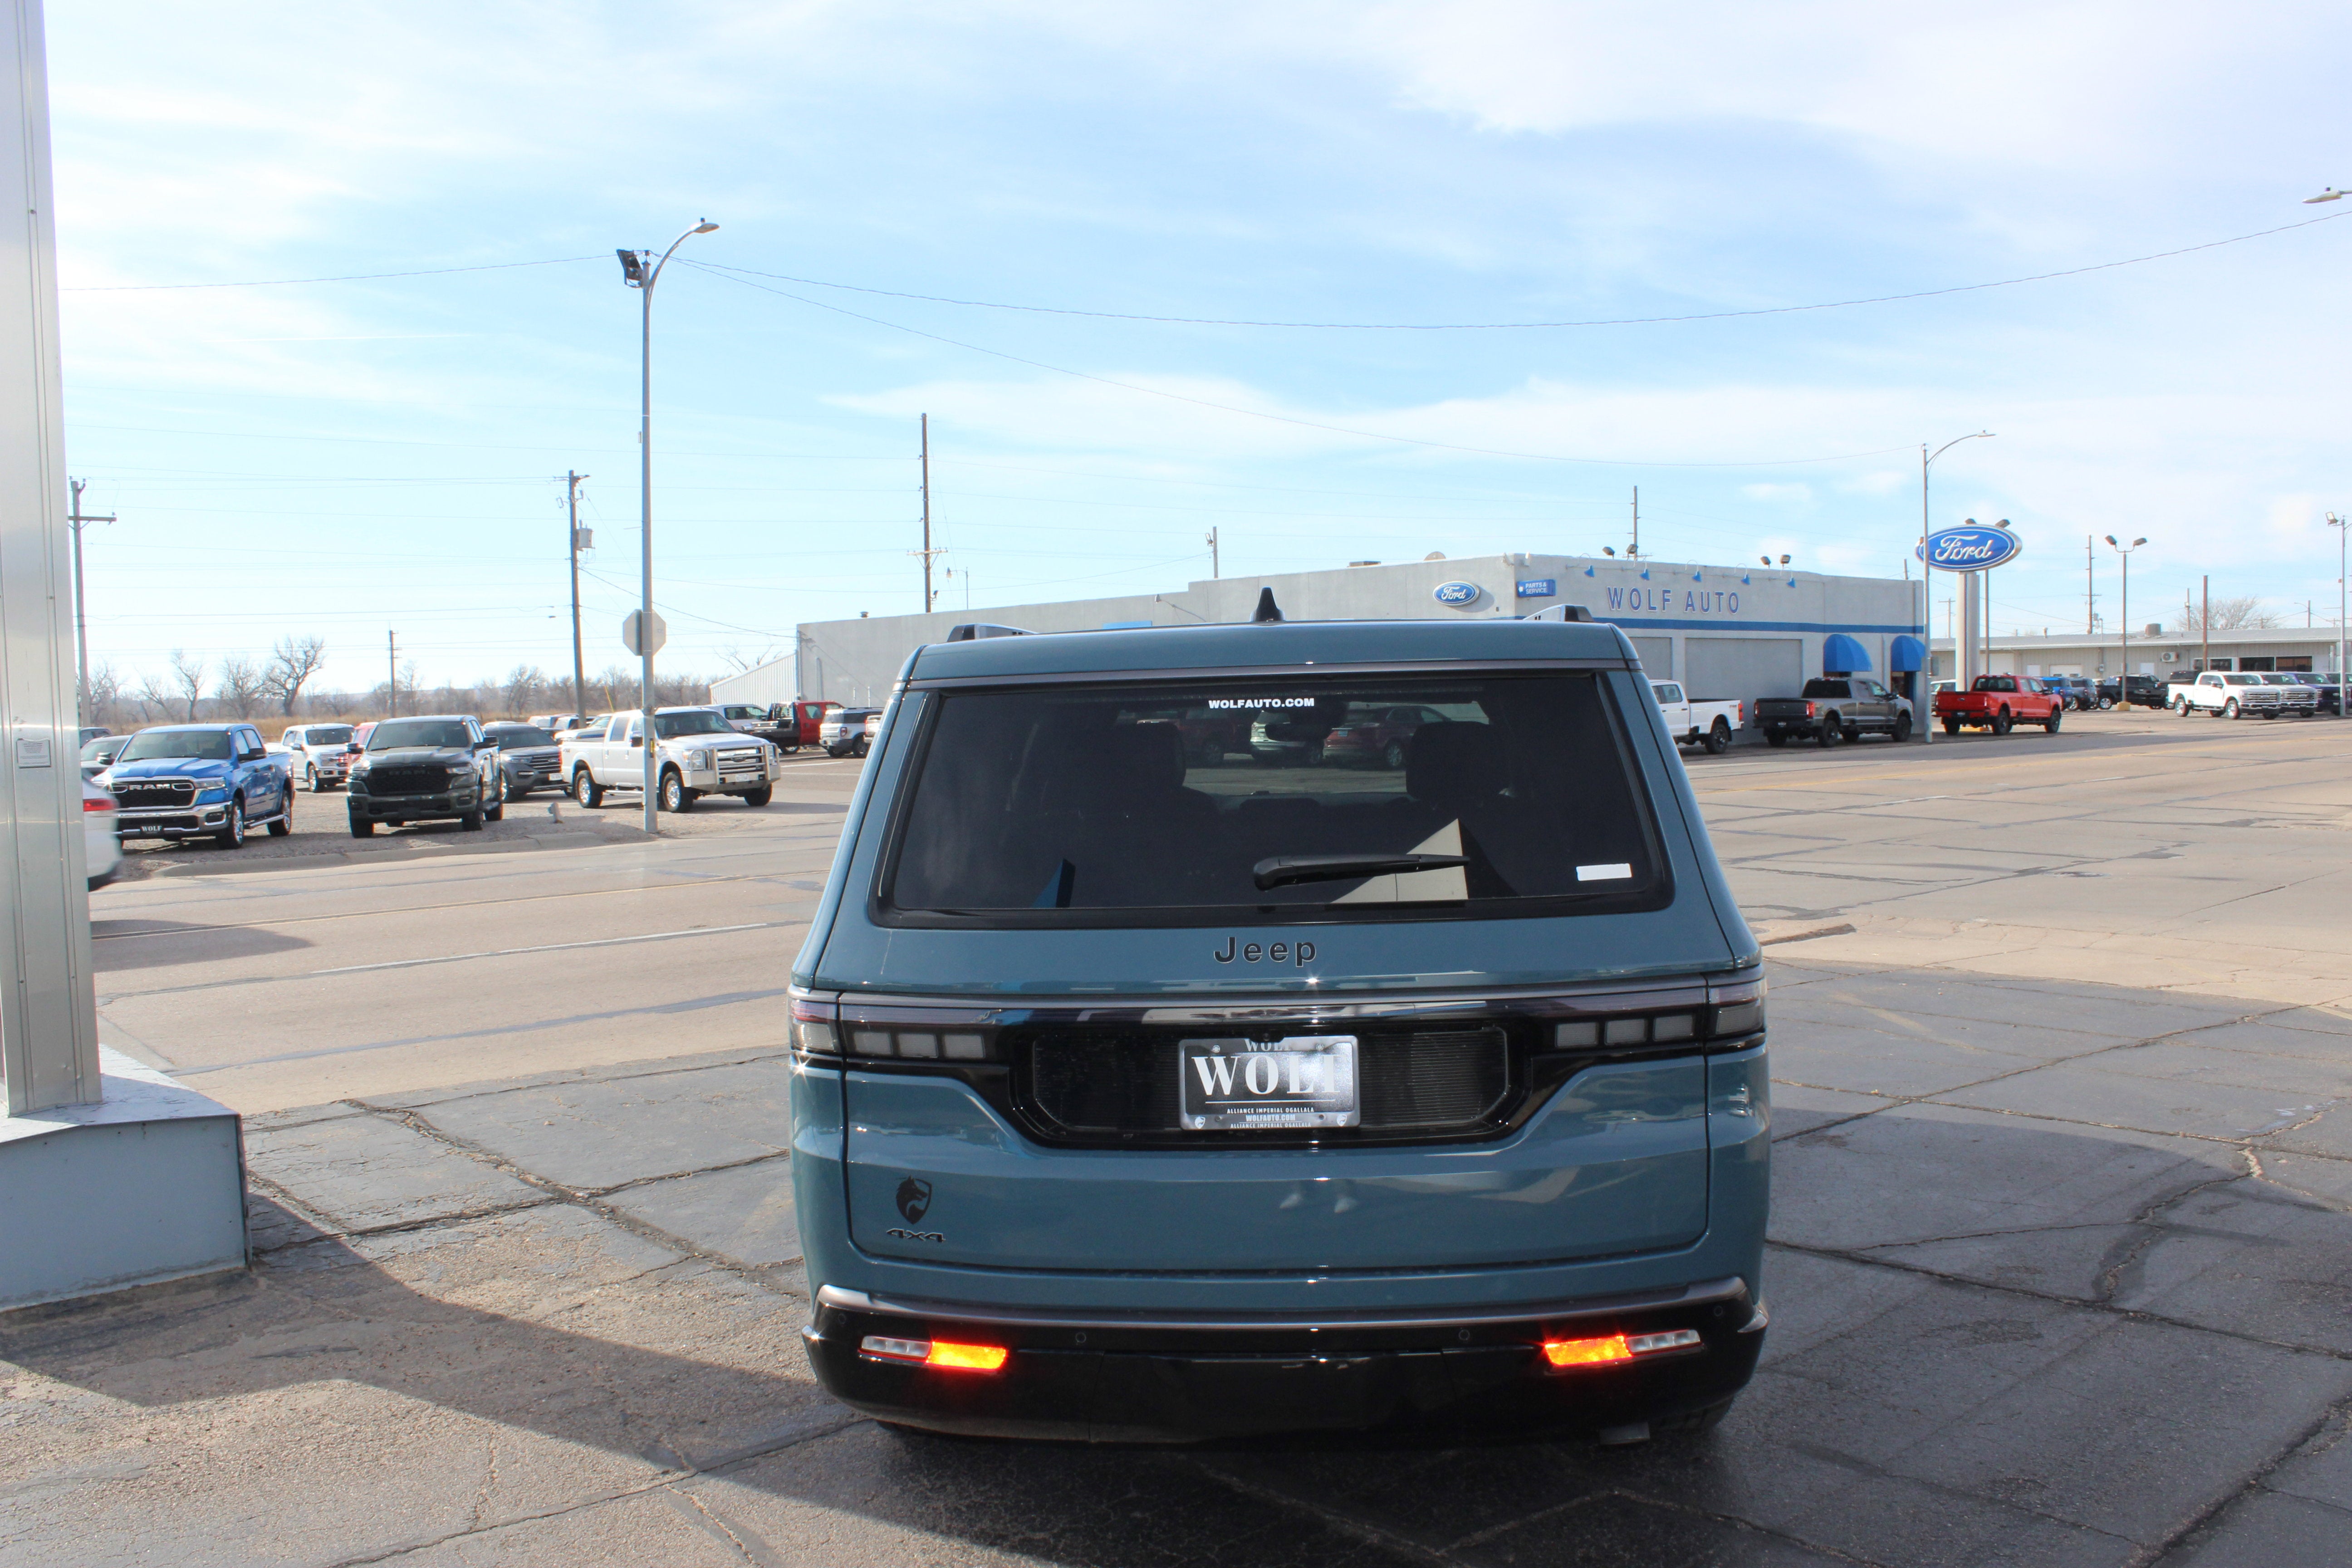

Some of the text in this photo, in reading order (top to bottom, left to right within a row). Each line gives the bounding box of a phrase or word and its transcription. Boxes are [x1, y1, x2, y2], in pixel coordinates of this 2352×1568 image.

[1935, 535, 1994, 561] Ford
[1441, 586, 1466, 600] Ford
[1607, 586, 1740, 614] WOLF AUTO
[1208, 698, 1314, 709] WOLFAUTO.COM
[1214, 936, 1316, 967] Jeep
[1191, 1054, 1344, 1096] WOLF
